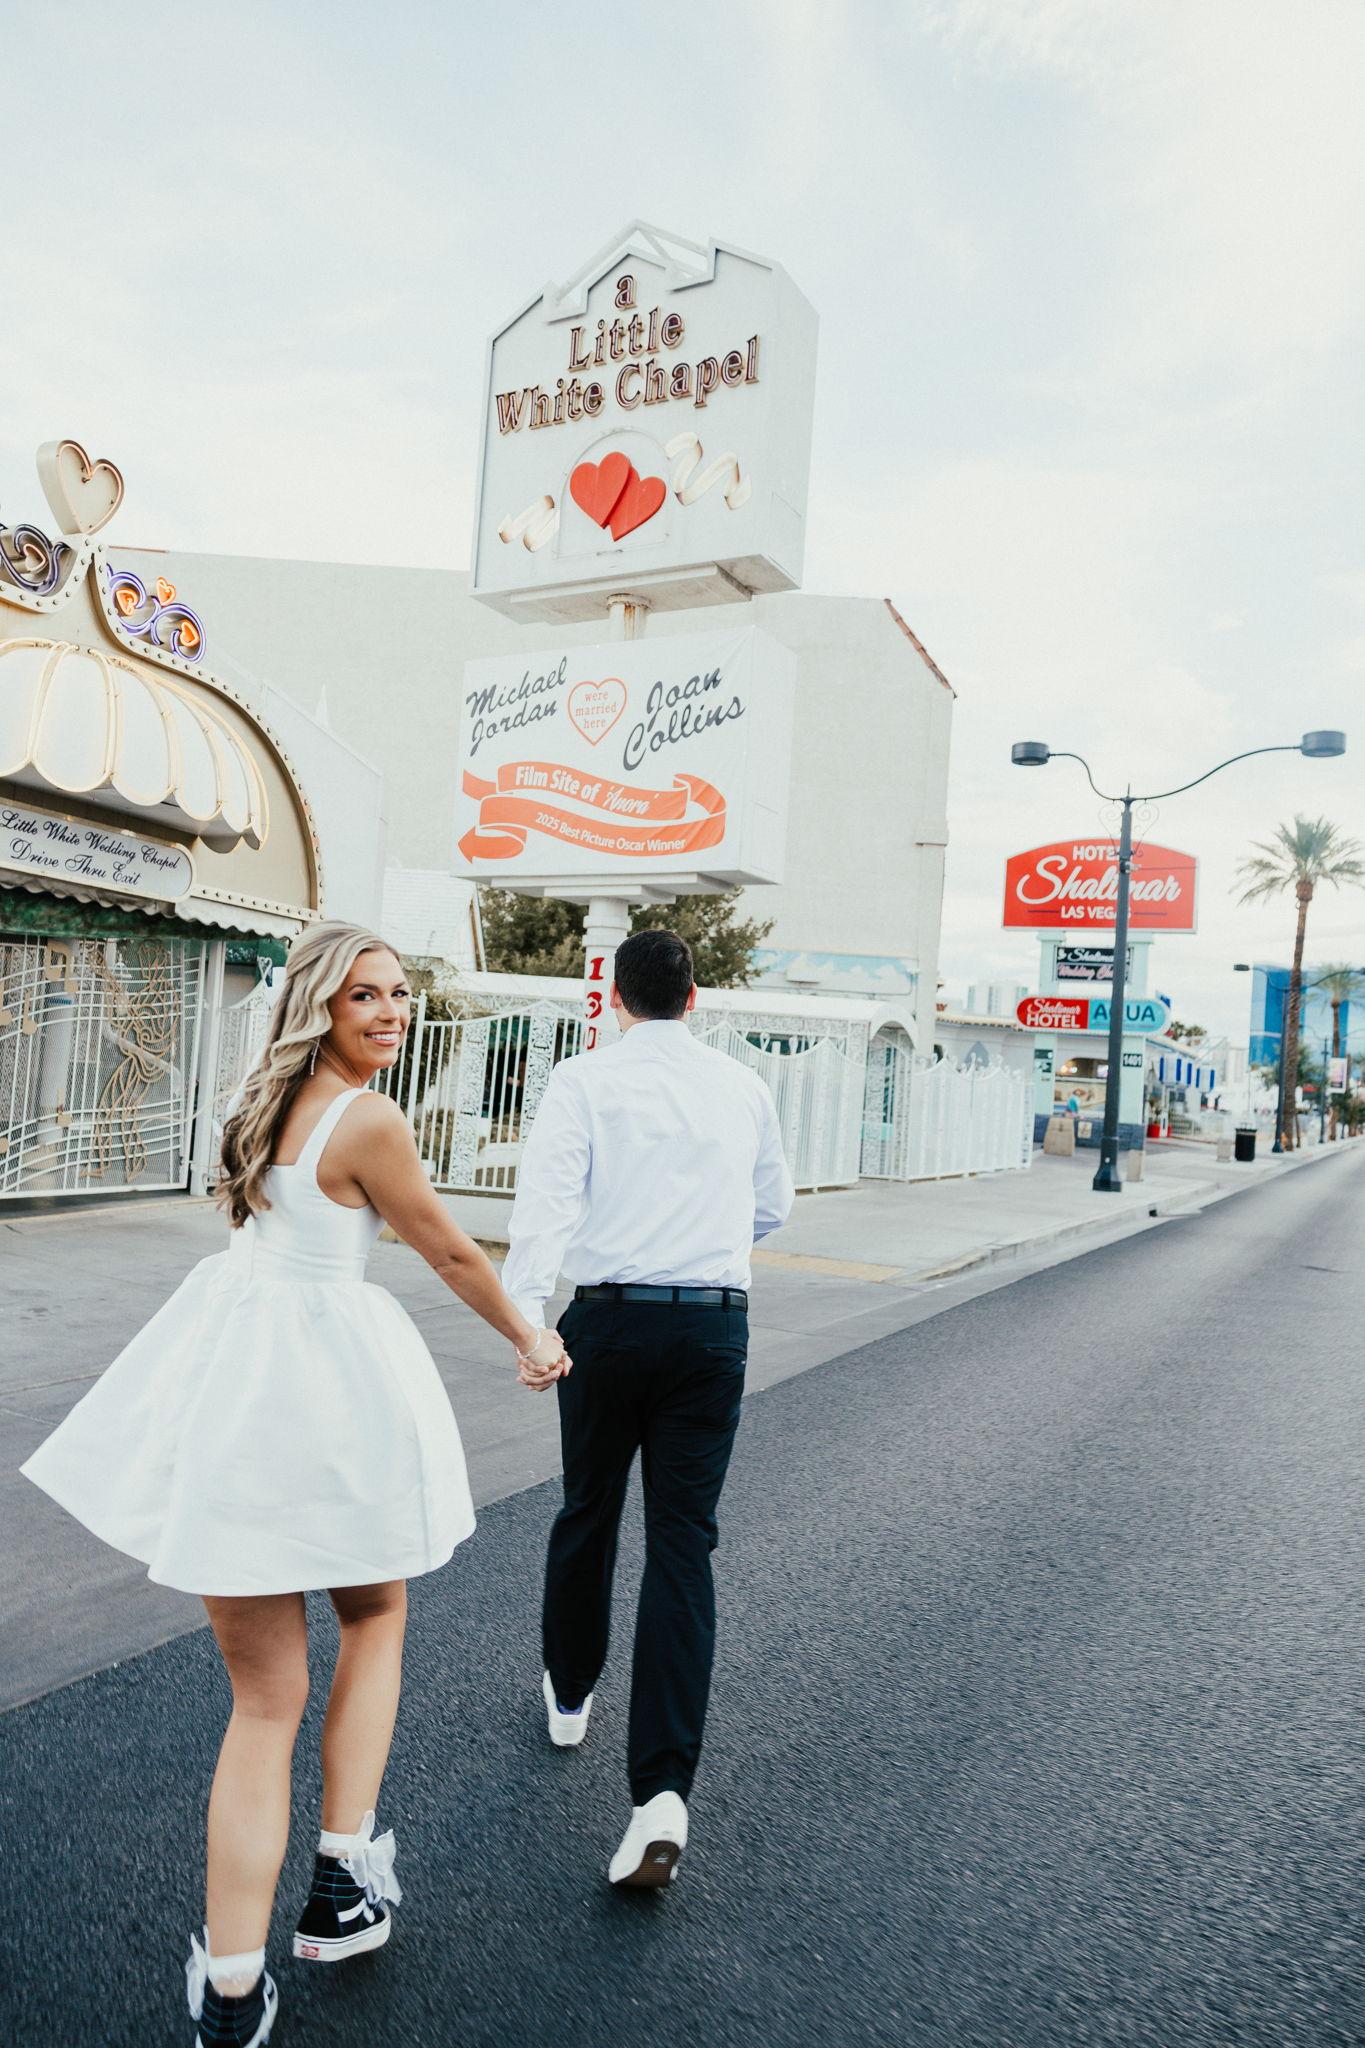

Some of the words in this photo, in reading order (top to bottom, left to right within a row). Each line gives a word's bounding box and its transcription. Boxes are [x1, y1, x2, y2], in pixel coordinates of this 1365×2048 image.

[614, 273, 638, 309] a
[567, 306, 685, 372] Little
[495, 378, 606, 435] White
[615, 334, 760, 411] Chapel
[465, 655, 568, 718] Michael
[584, 690, 609, 702] were
[645, 667, 726, 730] Joan
[470, 697, 560, 757] Jordan
[575, 702, 617, 717] married
[583, 717, 607, 730] here
[622, 695, 746, 772] Collins
[515, 765, 548, 787] Film
[550, 769, 580, 795] Site
[580, 783, 602, 804] of
[0, 809, 38, 836] Little
[43, 820, 81, 846] White
[84, 831, 136, 862] Wedding
[141, 845, 181, 871] Chapel
[535, 811, 560, 831] 2025
[559, 821, 580, 839] Best
[581, 830, 615, 848] Picture
[616, 837, 646, 851] Oscar
[647, 839, 686, 852] Winner
[10, 837, 59, 868] Drive
[65, 853, 107, 878] Thru
[112, 861, 143, 886] Exit
[1061, 905, 1085, 919] LAS
[1087, 906, 1131, 920] VEG
[1026, 1012, 1081, 1028] HOTEL
[1027, 998, 1081, 1015] Shalimar
[1093, 1004, 1156, 1022] AUA
